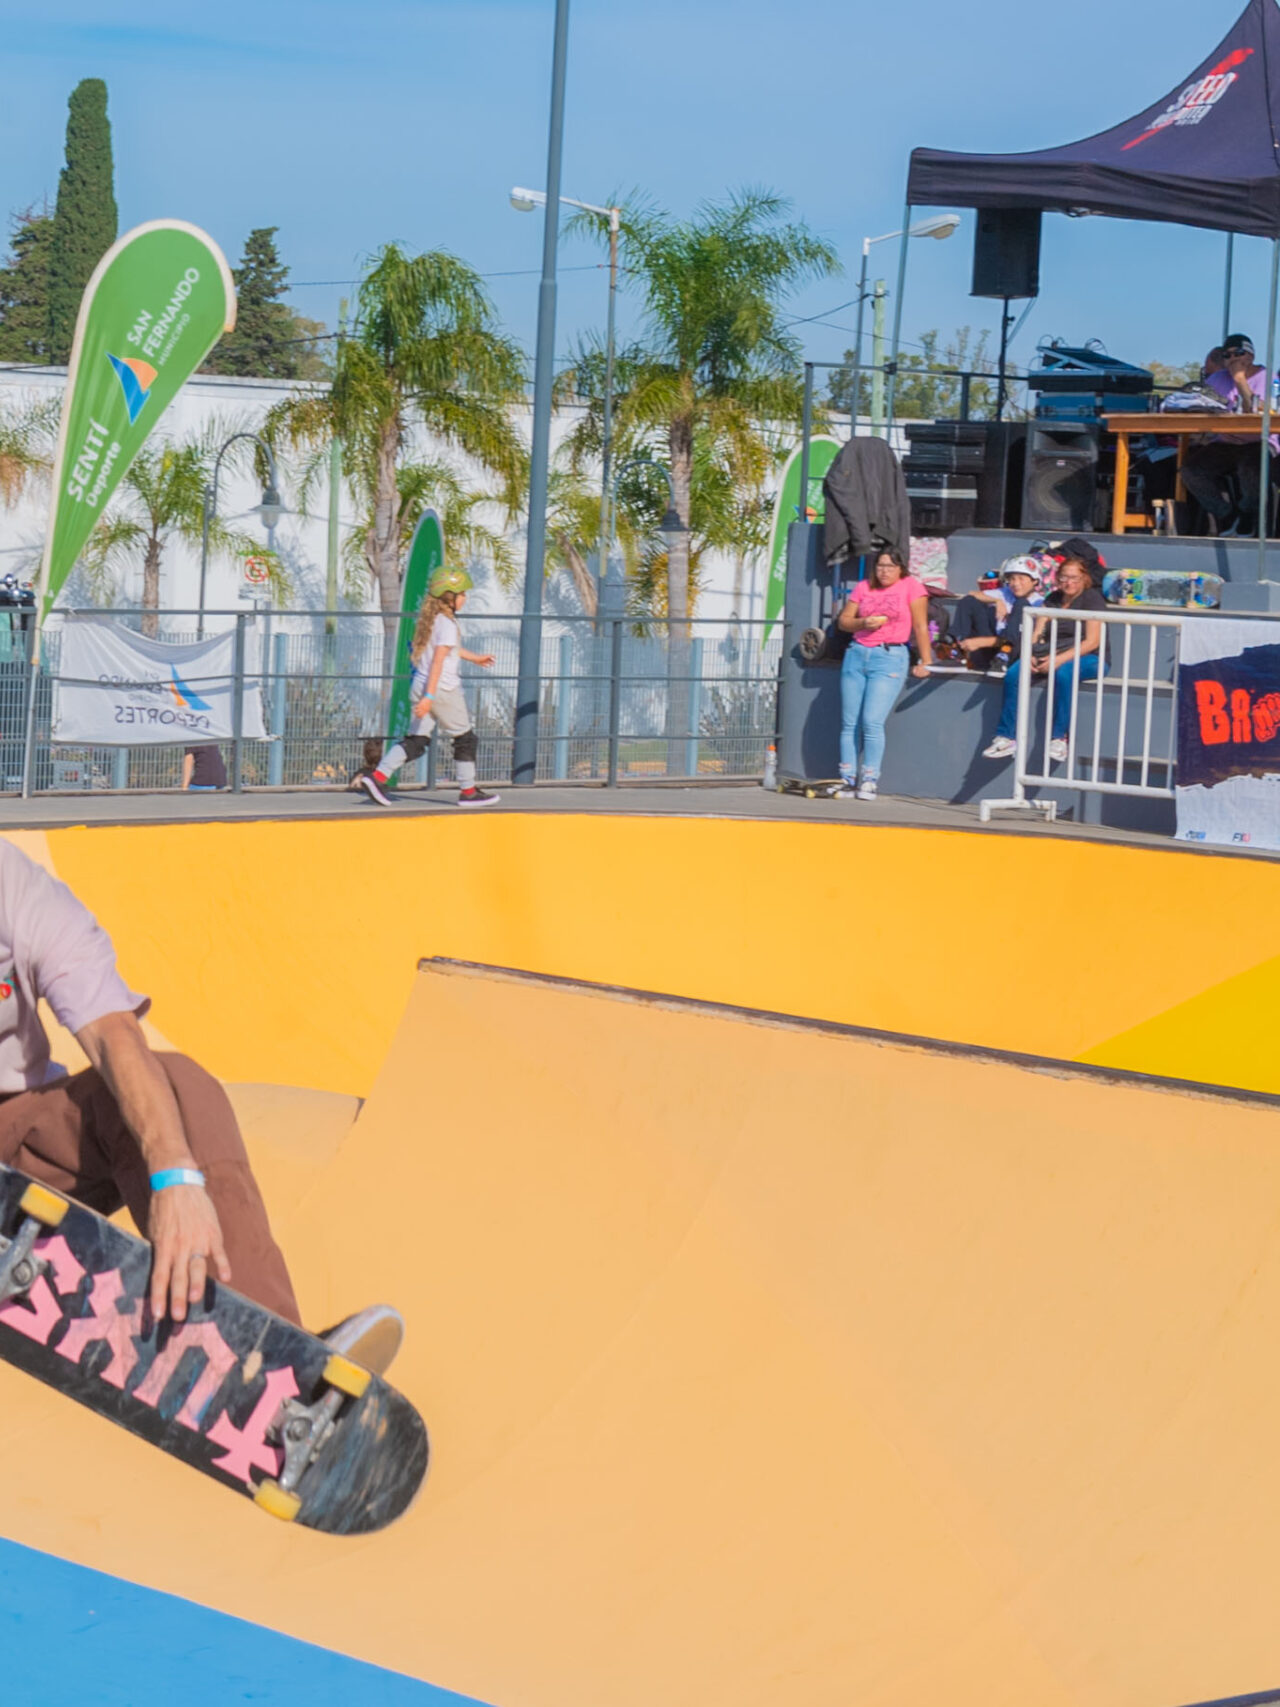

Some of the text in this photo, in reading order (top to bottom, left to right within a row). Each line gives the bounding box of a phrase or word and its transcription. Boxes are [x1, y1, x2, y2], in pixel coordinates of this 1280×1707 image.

[127, 310, 154, 346] SAN
[143, 267, 200, 357] FERNANDO
[86, 442, 121, 508] Deporte
